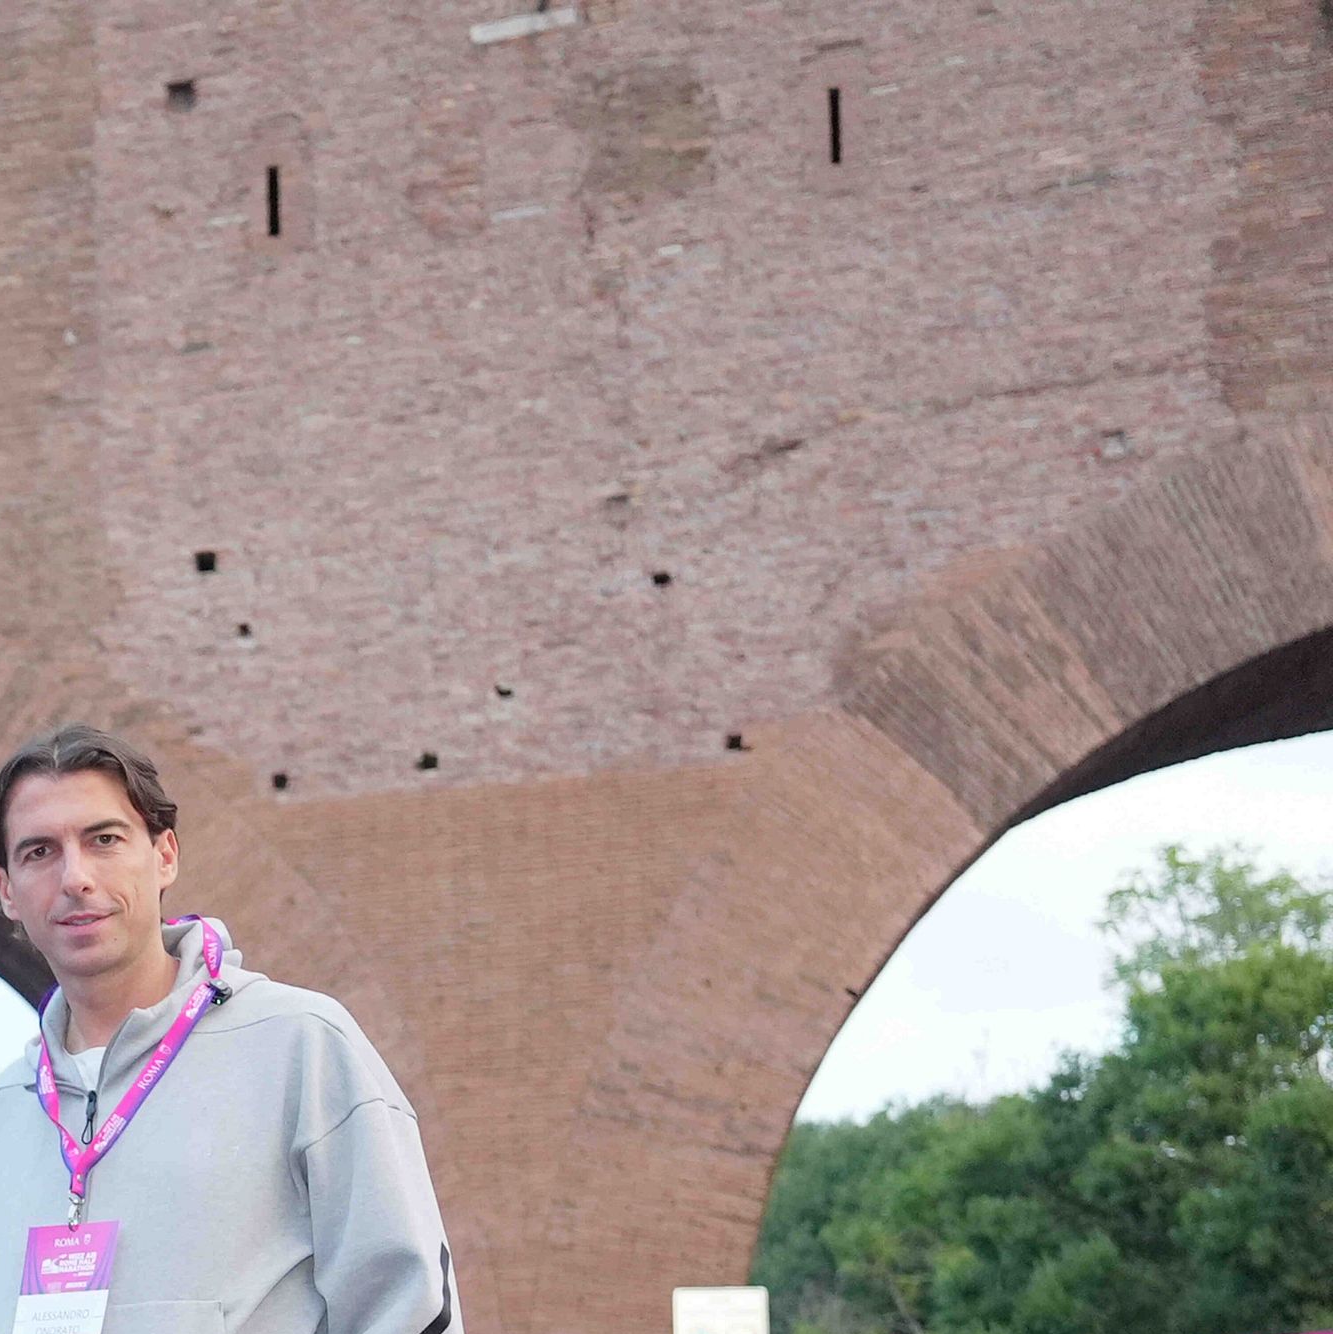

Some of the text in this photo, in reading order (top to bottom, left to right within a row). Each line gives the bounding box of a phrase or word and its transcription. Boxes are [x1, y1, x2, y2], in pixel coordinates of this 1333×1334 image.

[136, 1058, 166, 1091] ROMA
[54, 1238, 80, 1248] ROMA
[32, 1309, 90, 1322] ALESSANDRO
